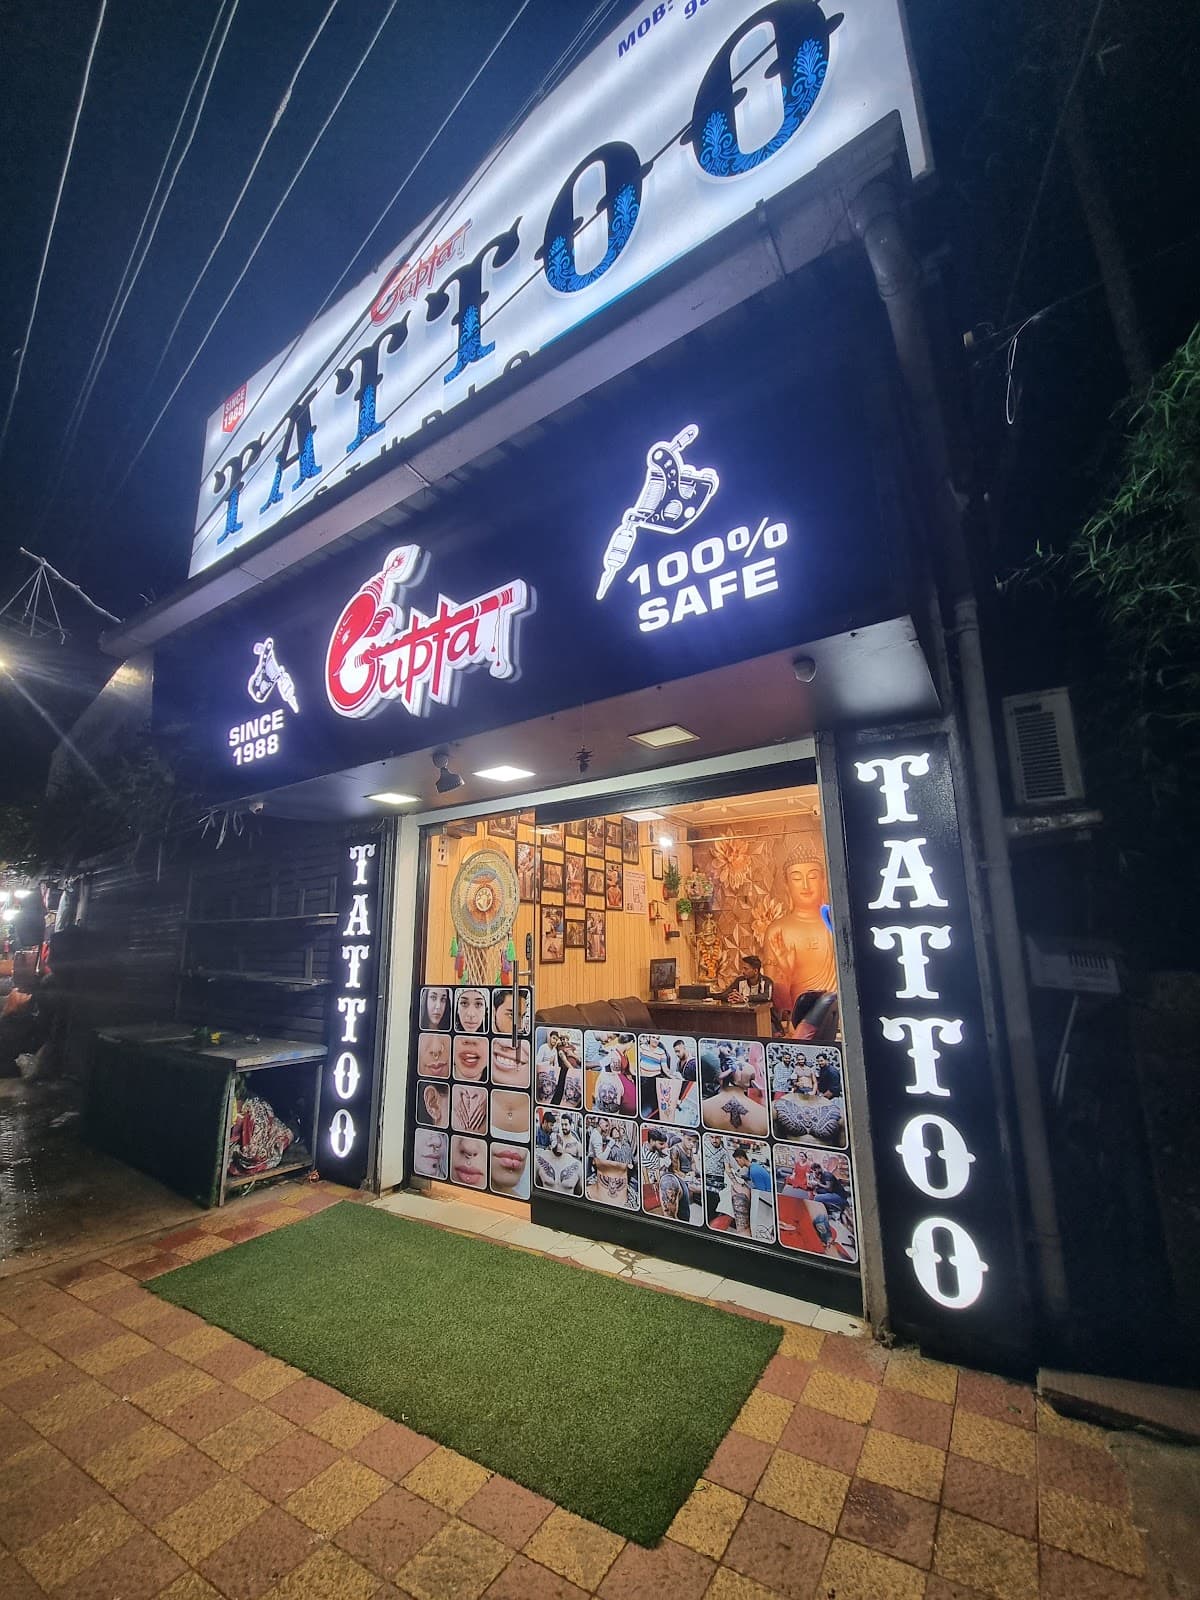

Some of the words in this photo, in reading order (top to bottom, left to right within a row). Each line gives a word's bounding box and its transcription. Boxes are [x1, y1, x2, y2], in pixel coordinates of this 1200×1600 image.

[213, 0, 845, 546] TATTOO
[225, 387, 246, 415] SINCE
[627, 516, 788, 596] 100%
[637, 556, 779, 633] SAFE
[326, 548, 520, 715] Gupta
[228, 708, 285, 747] SINCE
[232, 733, 280, 766] 1988
[328, 843, 377, 1159] TATTOO
[853, 752, 989, 1309] TATTOO
